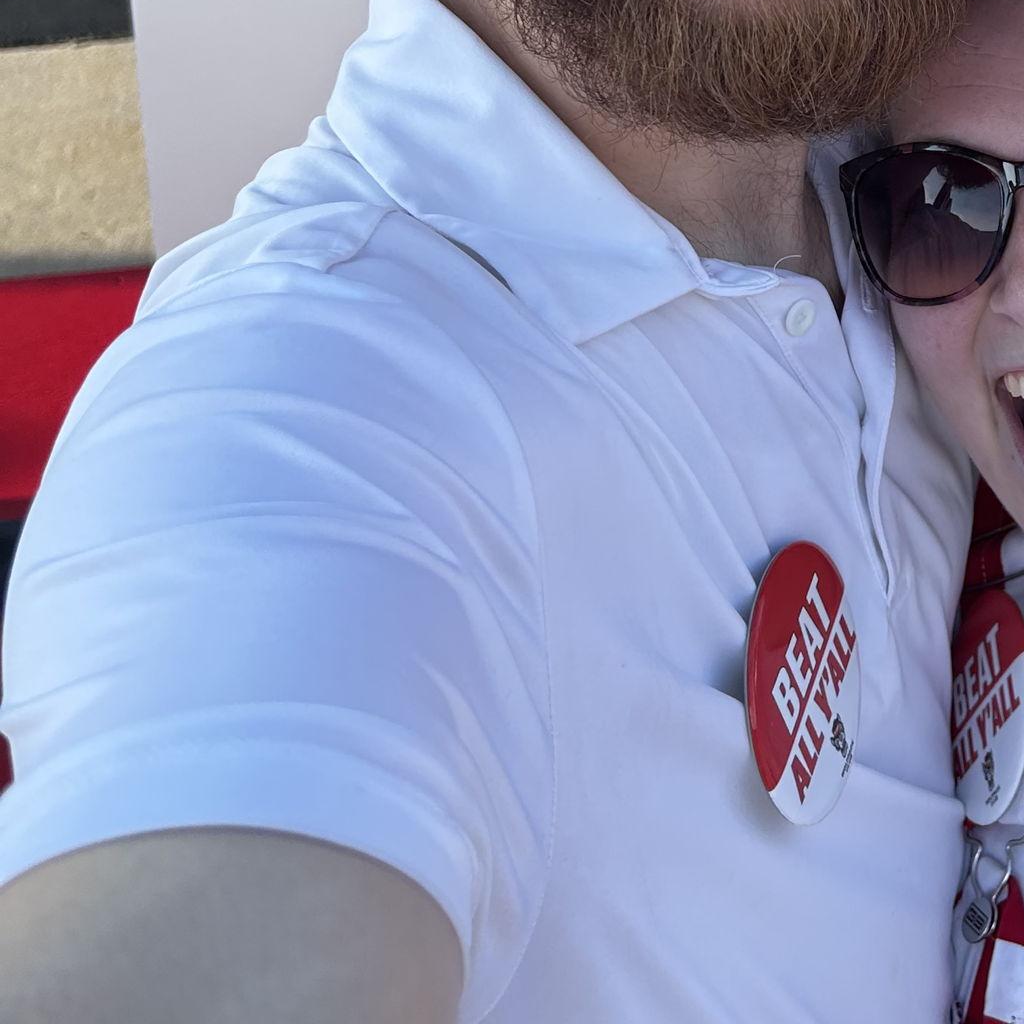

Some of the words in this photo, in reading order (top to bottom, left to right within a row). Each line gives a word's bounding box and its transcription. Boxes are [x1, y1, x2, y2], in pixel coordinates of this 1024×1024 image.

[771, 572, 831, 735] BEAT
[789, 713, 825, 805] ALL
[814, 614, 857, 723] Y'ALL
[953, 622, 1002, 729] BEAT
[977, 672, 1021, 750] Y'ALL
